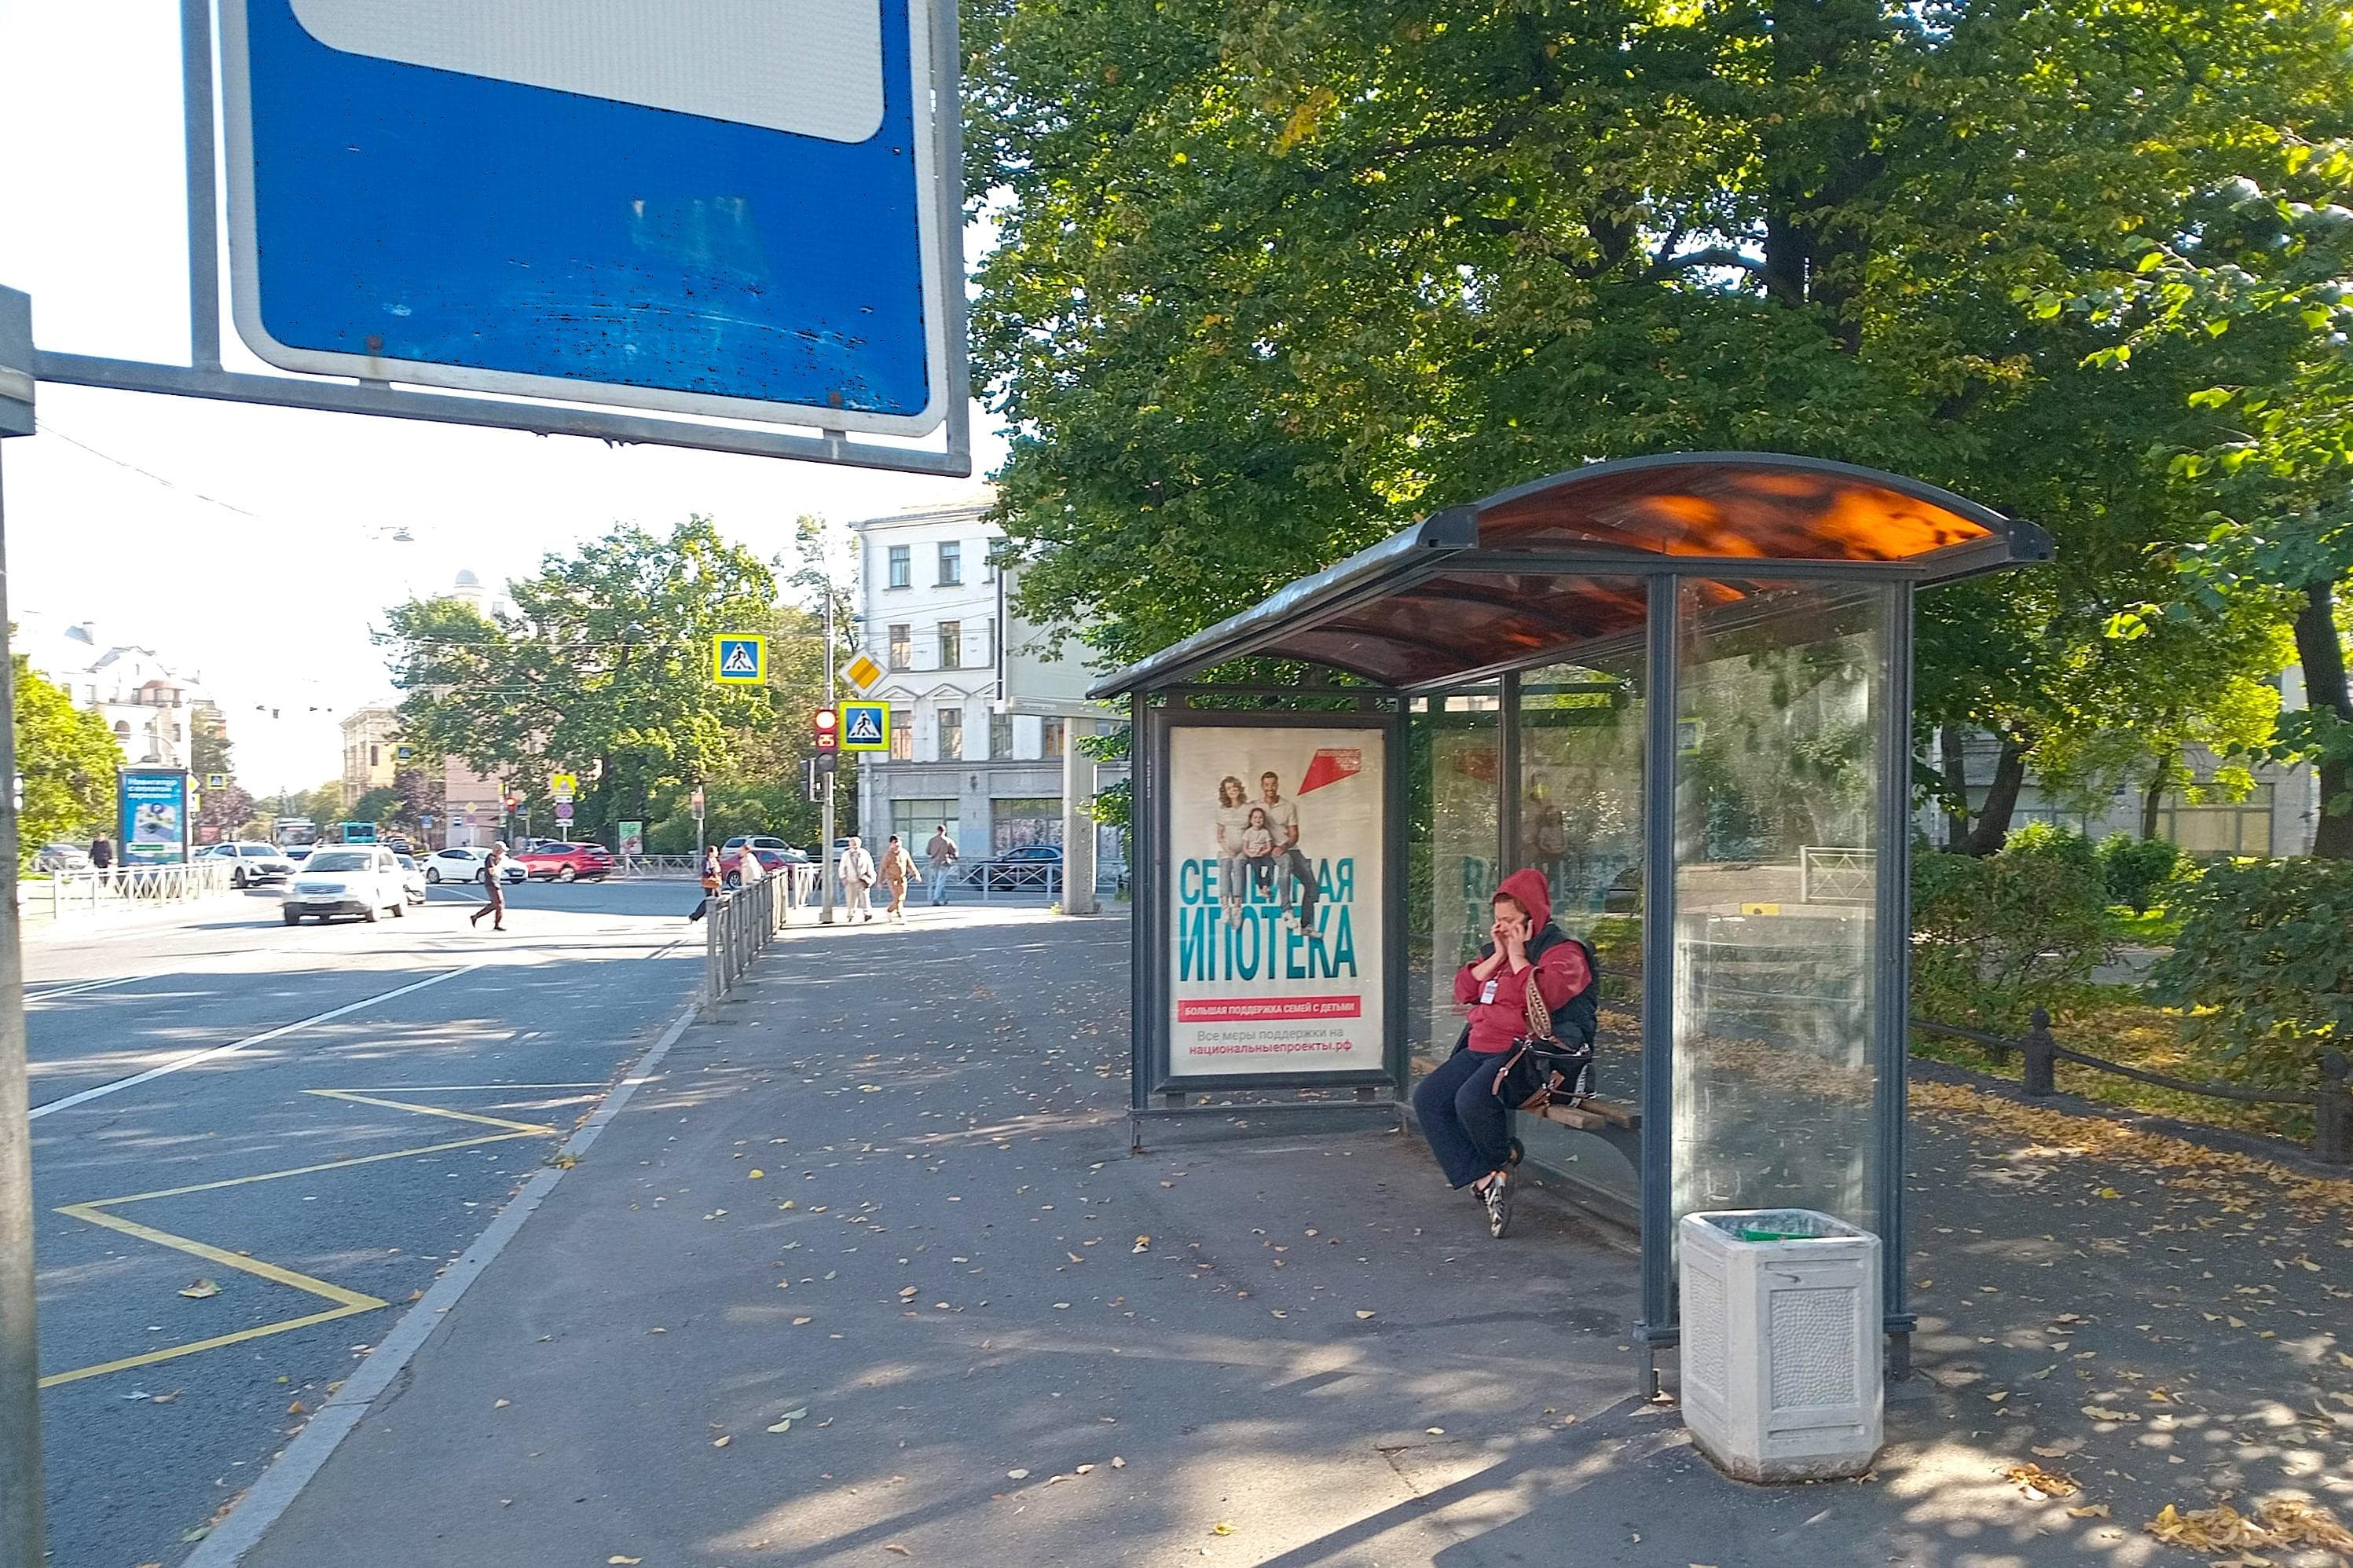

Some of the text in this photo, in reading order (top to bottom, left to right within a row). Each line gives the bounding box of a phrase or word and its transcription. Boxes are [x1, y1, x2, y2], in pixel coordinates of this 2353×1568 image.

[1180, 857, 1354, 905] СЕЕАЯ
[1179, 903, 1358, 982] ИПОТЕКА
[1185, 1002, 1355, 1016] БОЛЬШАЯ ПОДДЕРЖКА СЕМЕЙ С ДЕТЬМИ
[1197, 1028, 1344, 1043] Все меры поддержки на
[1189, 1039, 1352, 1057] национальныепроекты.рф
